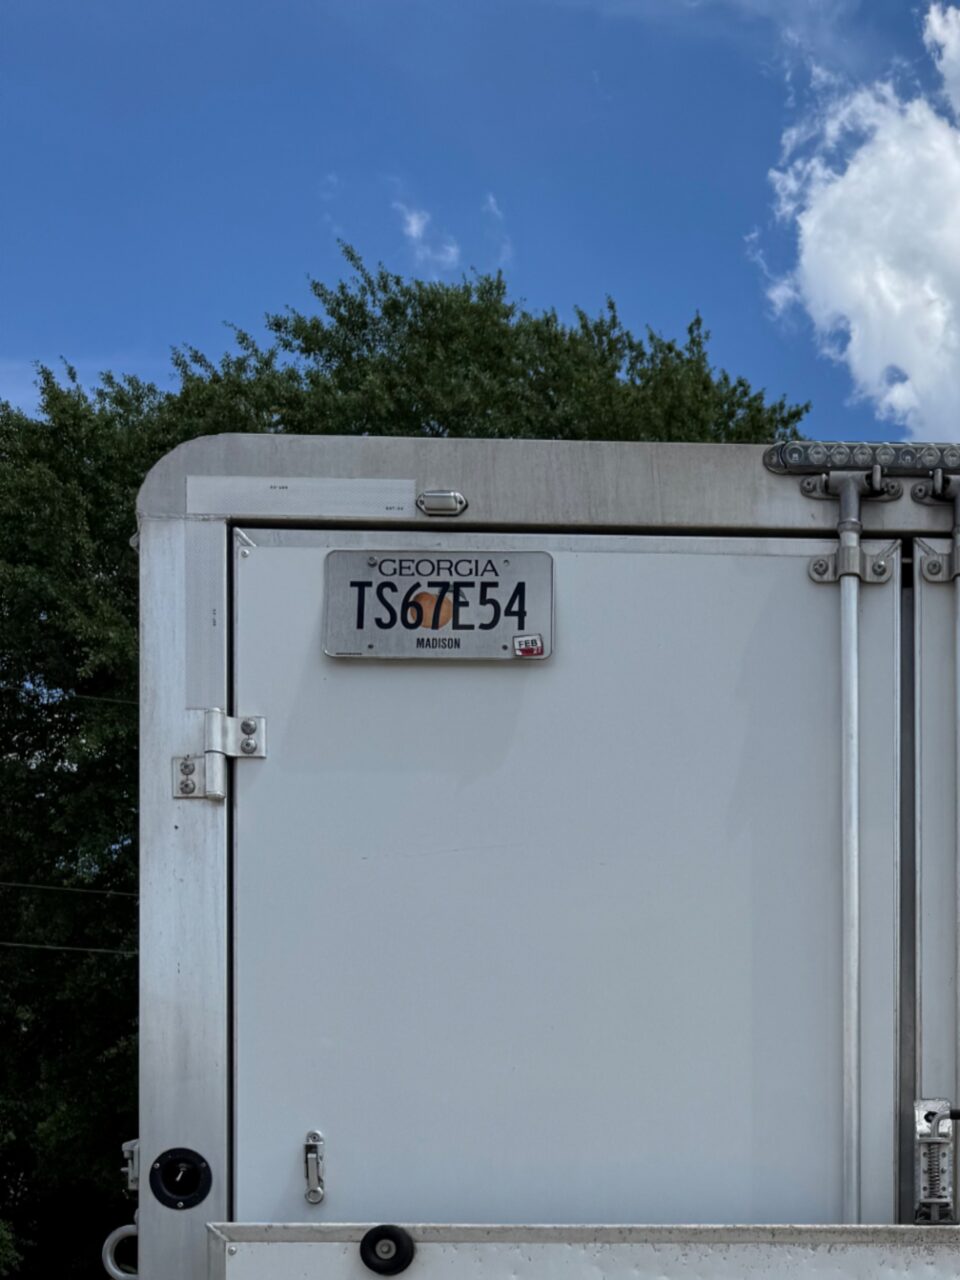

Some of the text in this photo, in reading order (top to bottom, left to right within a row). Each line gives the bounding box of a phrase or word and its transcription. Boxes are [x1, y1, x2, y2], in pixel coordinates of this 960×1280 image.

[377, 558, 500, 577] GEORGIA
[349, 580, 528, 631] TS67E54
[416, 637, 461, 650] MADISON
[518, 639, 538, 648] FEB
